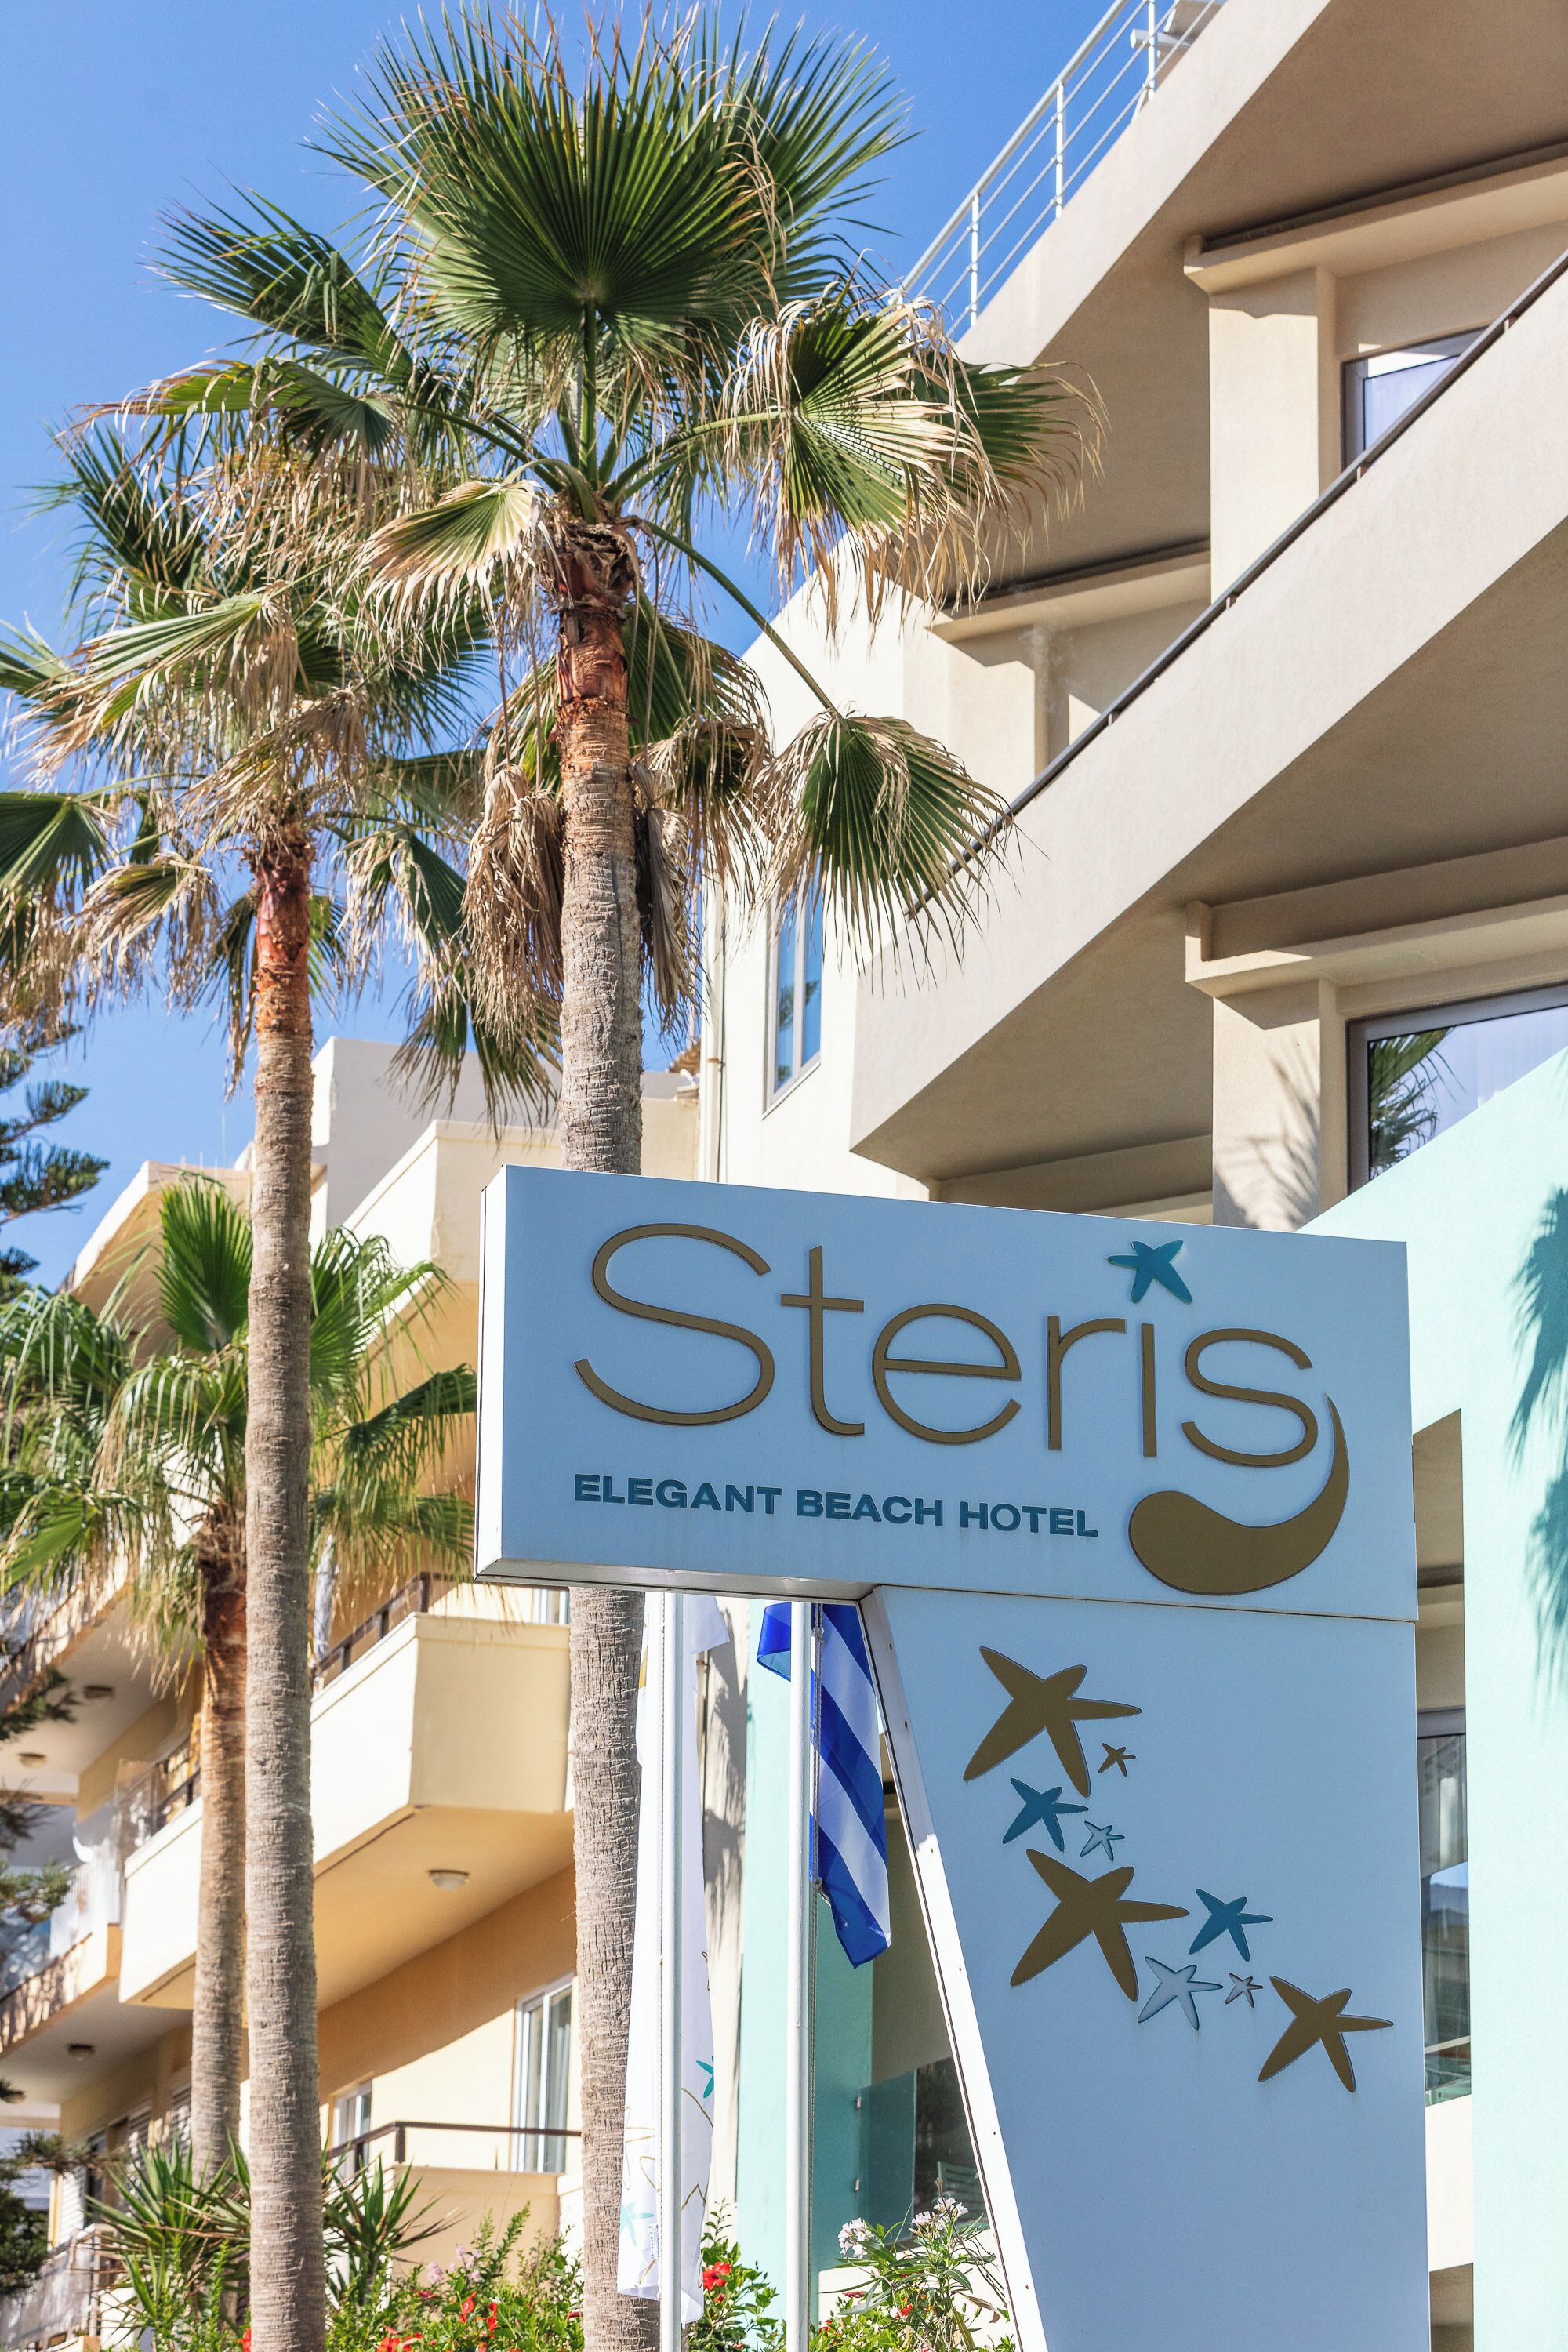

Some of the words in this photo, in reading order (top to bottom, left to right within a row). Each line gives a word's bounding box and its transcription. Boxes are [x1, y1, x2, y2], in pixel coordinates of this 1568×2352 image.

[573, 1223, 1319, 1468] Steris
[574, 1473, 783, 1518] ELEGANT
[796, 1489, 944, 1527] BEACH
[959, 1501, 1098, 1538] HOTEL
